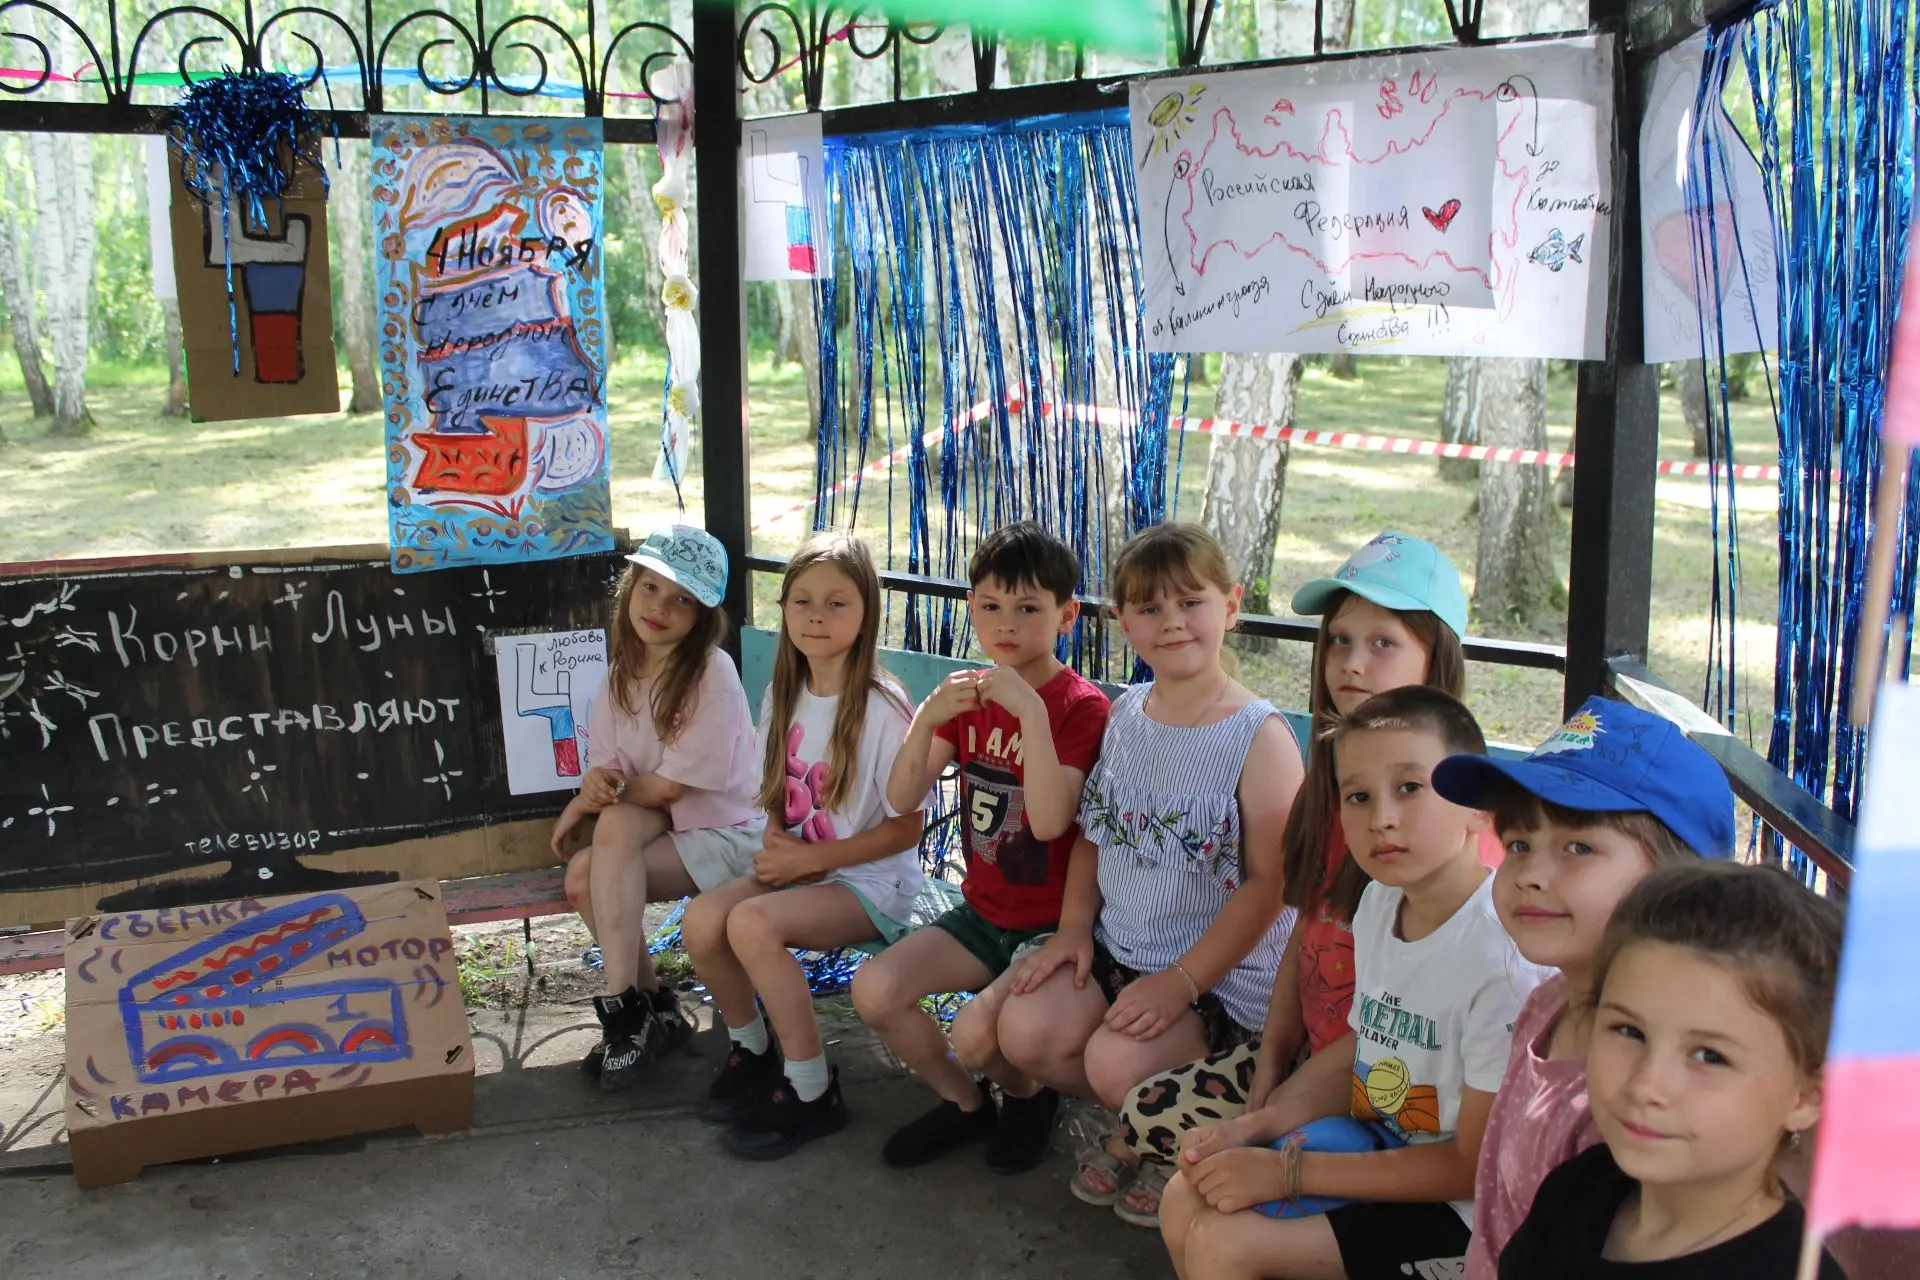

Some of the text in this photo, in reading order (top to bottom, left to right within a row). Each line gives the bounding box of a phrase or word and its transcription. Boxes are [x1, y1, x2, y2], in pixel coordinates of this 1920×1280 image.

[426, 227, 449, 275] 4
[311, 590, 457, 651] Луны
[968, 725, 1024, 766] I AM
[971, 789, 1000, 832] 5
[327, 936, 453, 969] МОТОР
[1381, 991, 1402, 1007] THE
[1359, 994, 1442, 1051] KETBALL
[1360, 1025, 1400, 1051] PLAYER
[110, 1068, 322, 1121] КАМЕРА
